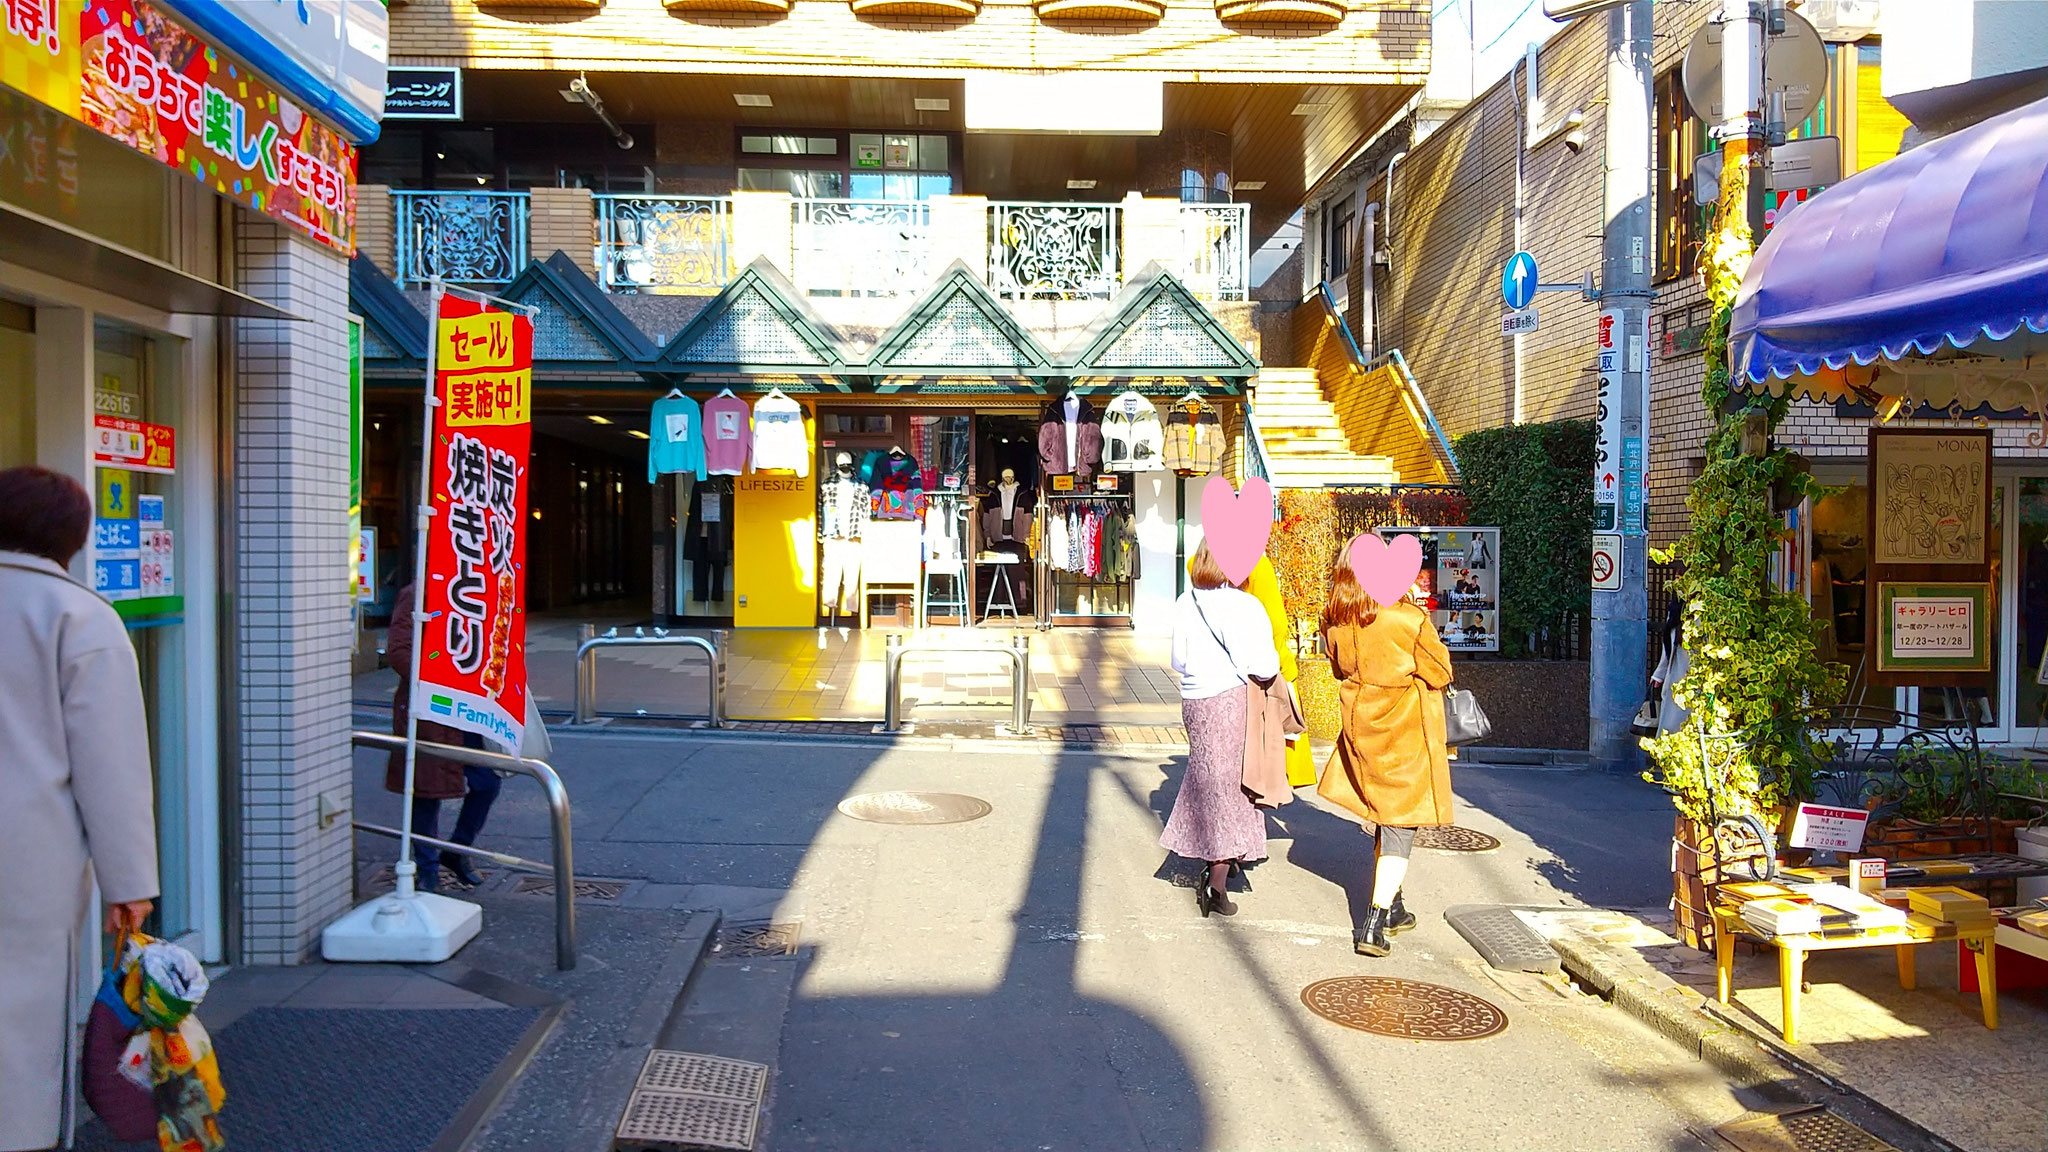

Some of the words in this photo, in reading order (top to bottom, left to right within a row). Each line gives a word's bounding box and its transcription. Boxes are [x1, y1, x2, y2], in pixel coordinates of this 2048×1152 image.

[104, 33, 346, 214] おうちで楽しくすごそう!
[449, 321, 508, 362] セール
[1503, 314, 1536, 332] 自転車を除く
[451, 376, 521, 420] 実施中!
[1937, 440, 1982, 452] MONA
[488, 447, 517, 576] 炭火
[1628, 502, 1640, 513] 35
[448, 433, 487, 673] 焼きとり
[1898, 606, 1967, 616] ギャラリーヒロ
